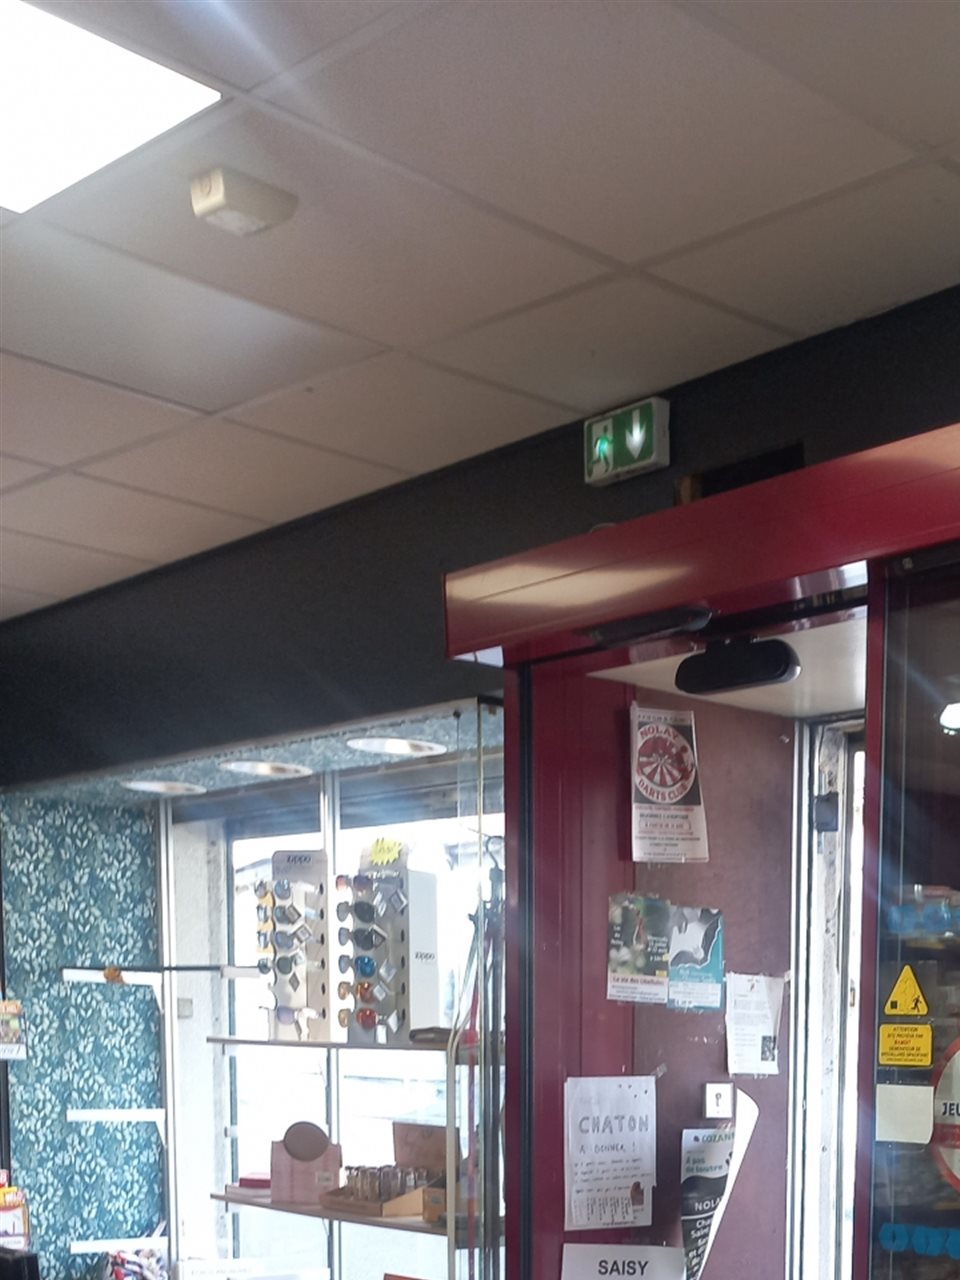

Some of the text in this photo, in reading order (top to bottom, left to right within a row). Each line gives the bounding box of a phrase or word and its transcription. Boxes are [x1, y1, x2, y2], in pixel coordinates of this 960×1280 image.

[640, 725, 679, 741] NOLAY
[638, 777, 666, 802] DARTS
[578, 1115, 649, 1135] CHATON
[598, 1259, 649, 1276] SAISY
